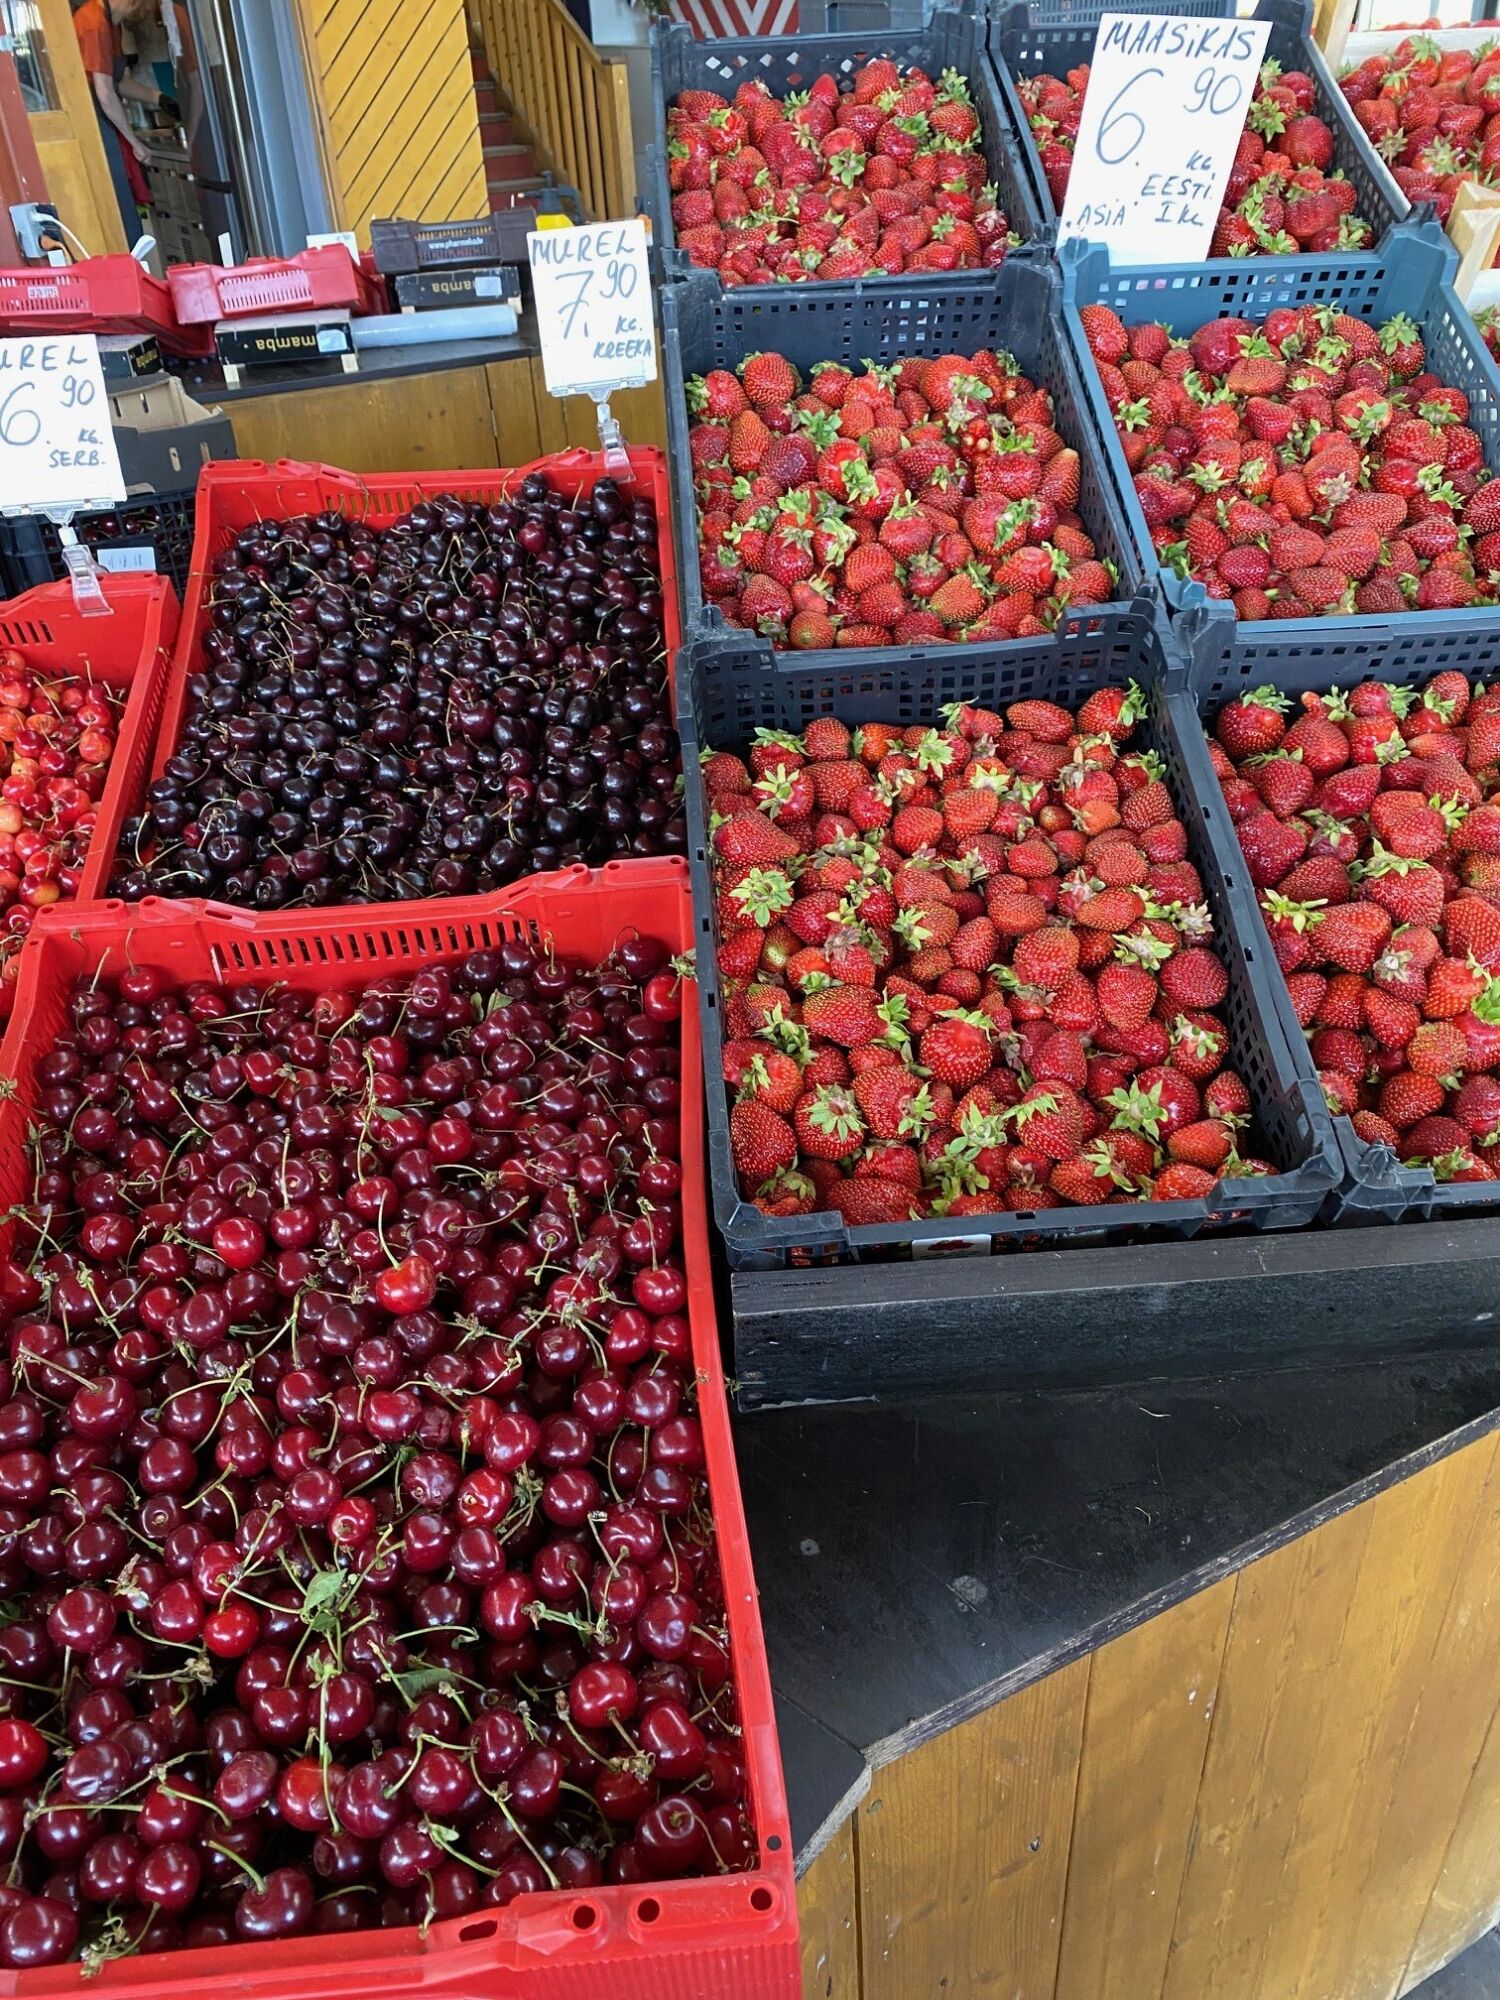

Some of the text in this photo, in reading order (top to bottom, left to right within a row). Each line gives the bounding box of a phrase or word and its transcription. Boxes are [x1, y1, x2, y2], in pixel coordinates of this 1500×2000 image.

[1183, 66, 1242, 115] 90
[531, 229, 635, 267] MUREL
[431, 280, 475, 294] amba
[599, 259, 638, 299] 90
[255, 334, 316, 352] mamba
[60, 374, 95, 408] 90
